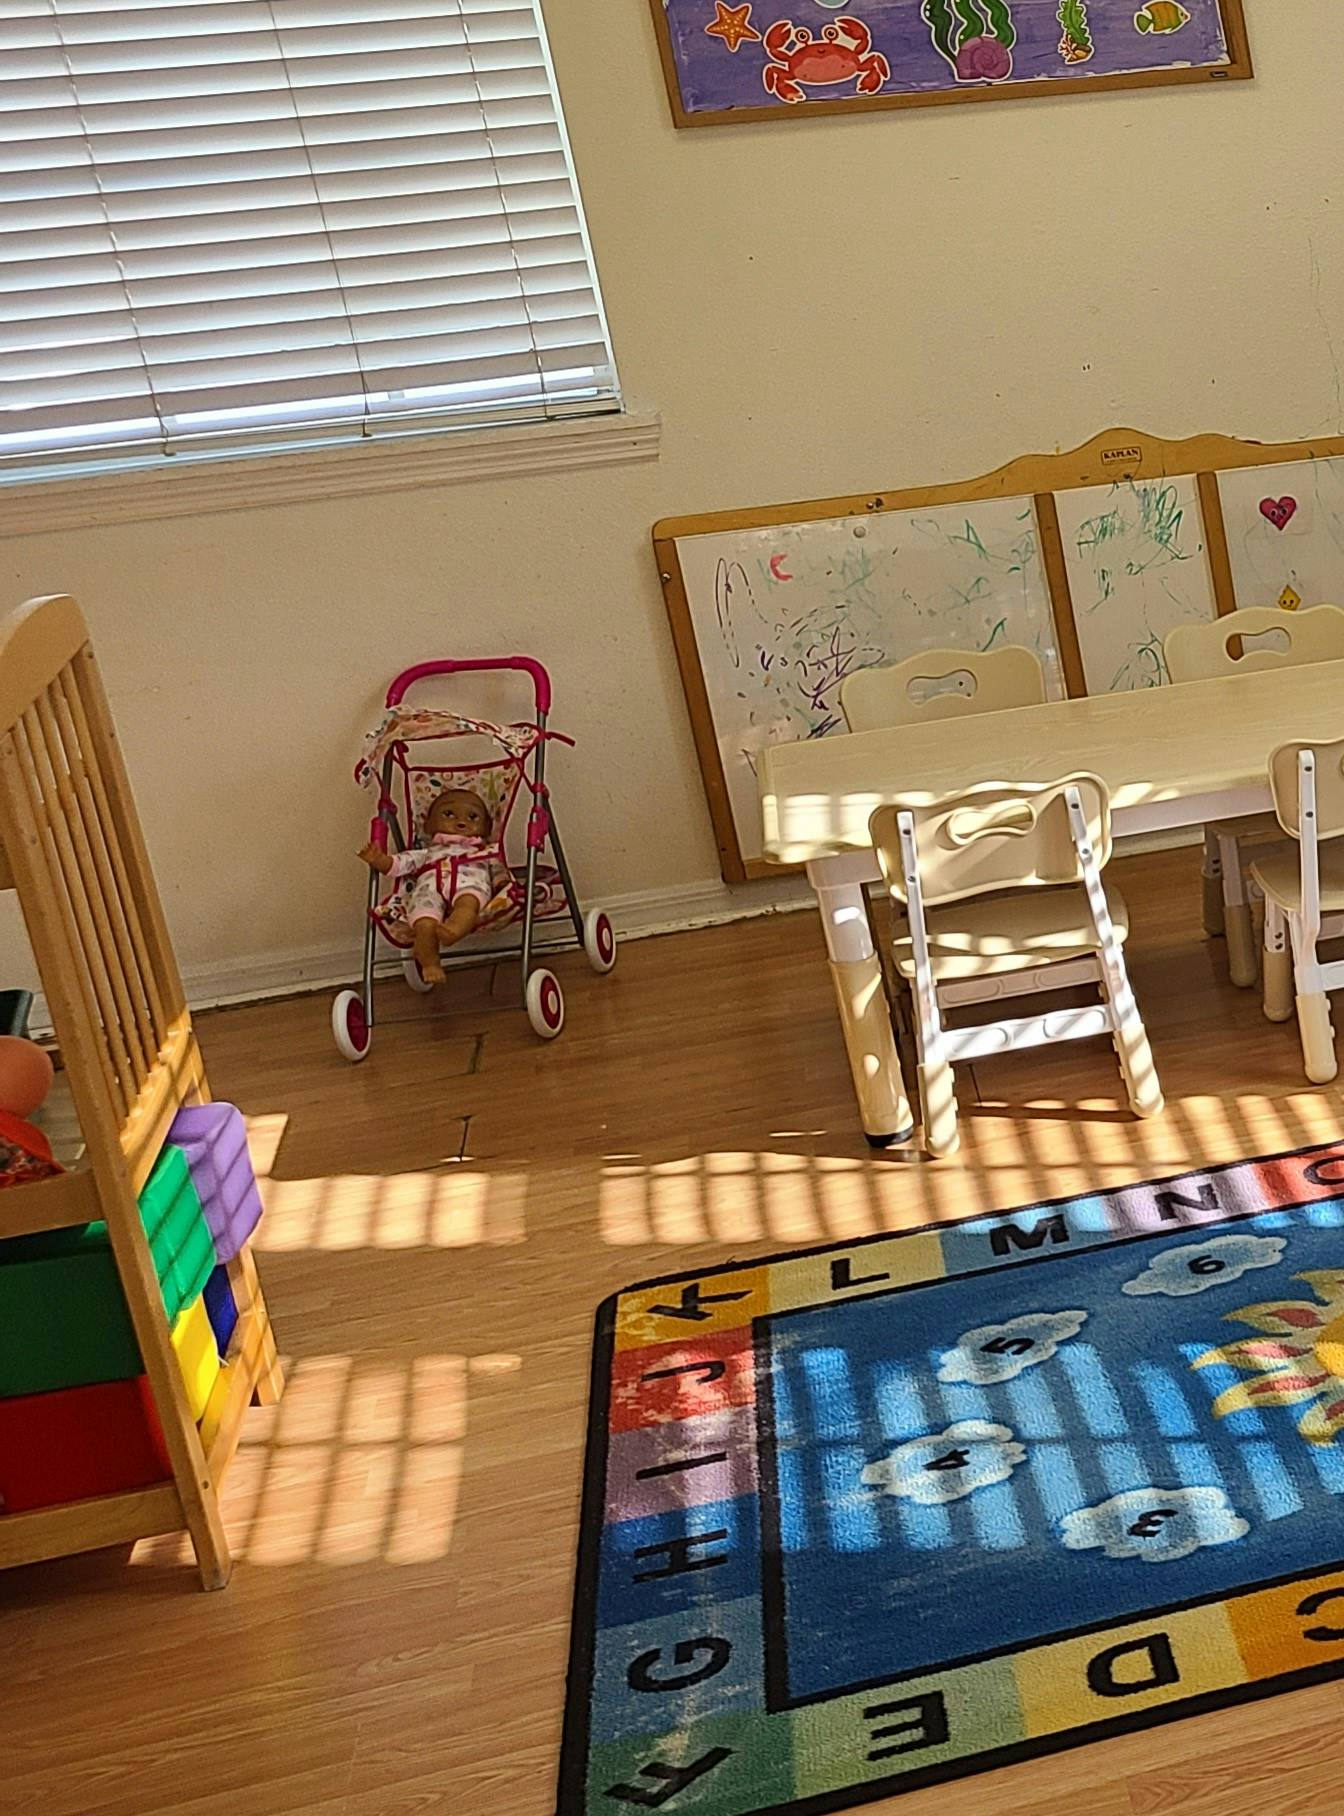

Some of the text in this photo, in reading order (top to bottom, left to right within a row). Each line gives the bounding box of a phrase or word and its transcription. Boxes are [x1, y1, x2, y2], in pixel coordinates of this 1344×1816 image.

[1103, 449, 1139, 459] KAPLAN
[647, 1282, 753, 1321] K
[831, 1258, 890, 1290] L
[991, 1215, 1071, 1257] M
[1157, 1183, 1222, 1222] N
[1188, 1255, 1227, 1277] 6
[981, 1335, 1035, 1359] 5
[922, 1447, 971, 1473] 4
[1129, 1509, 1179, 1537] 3
[604, 1360, 736, 1807] F G H I J
[1087, 1632, 1180, 1697] D
[862, 1690, 950, 1761] E
